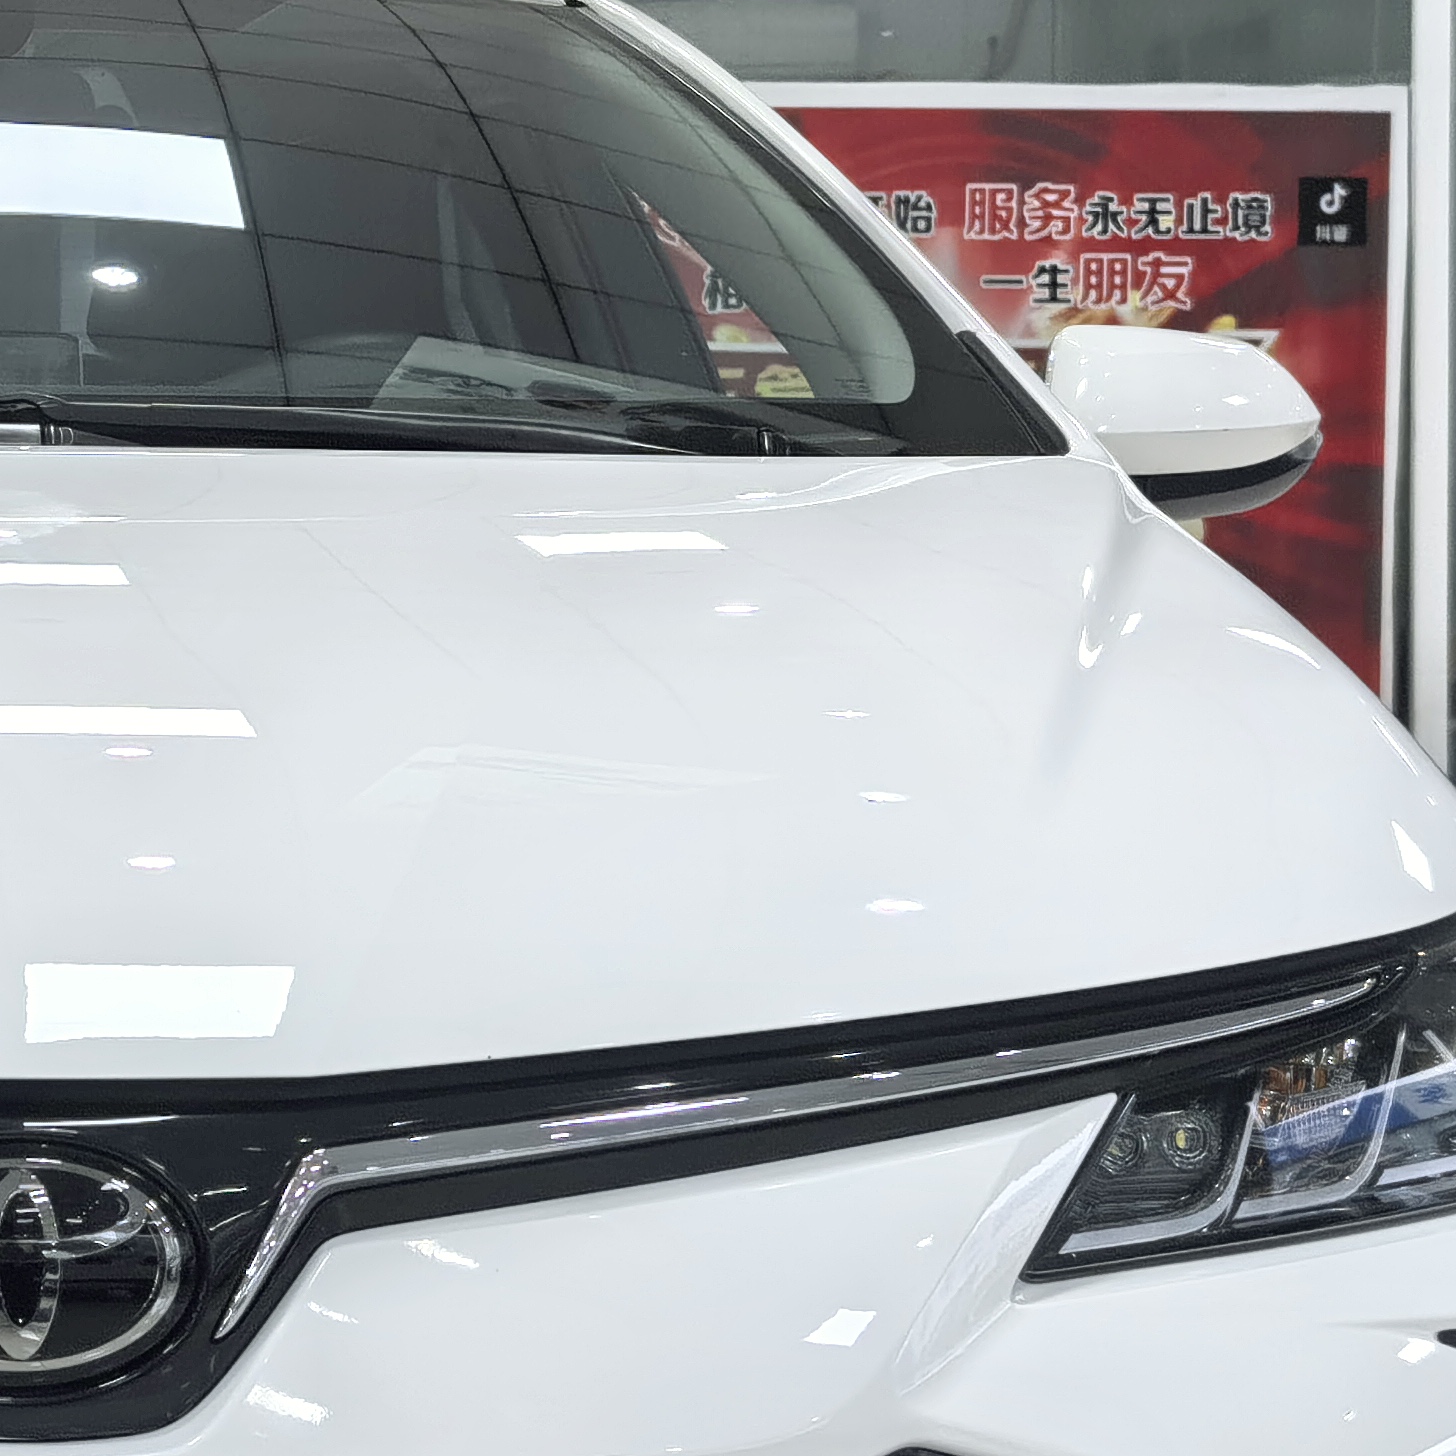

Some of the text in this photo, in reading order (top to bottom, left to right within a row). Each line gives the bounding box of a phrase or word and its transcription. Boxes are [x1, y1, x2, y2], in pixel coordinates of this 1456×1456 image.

[963, 182, 1273, 242] 服务永无止境
[980, 251, 1194, 311] 一生朋友
